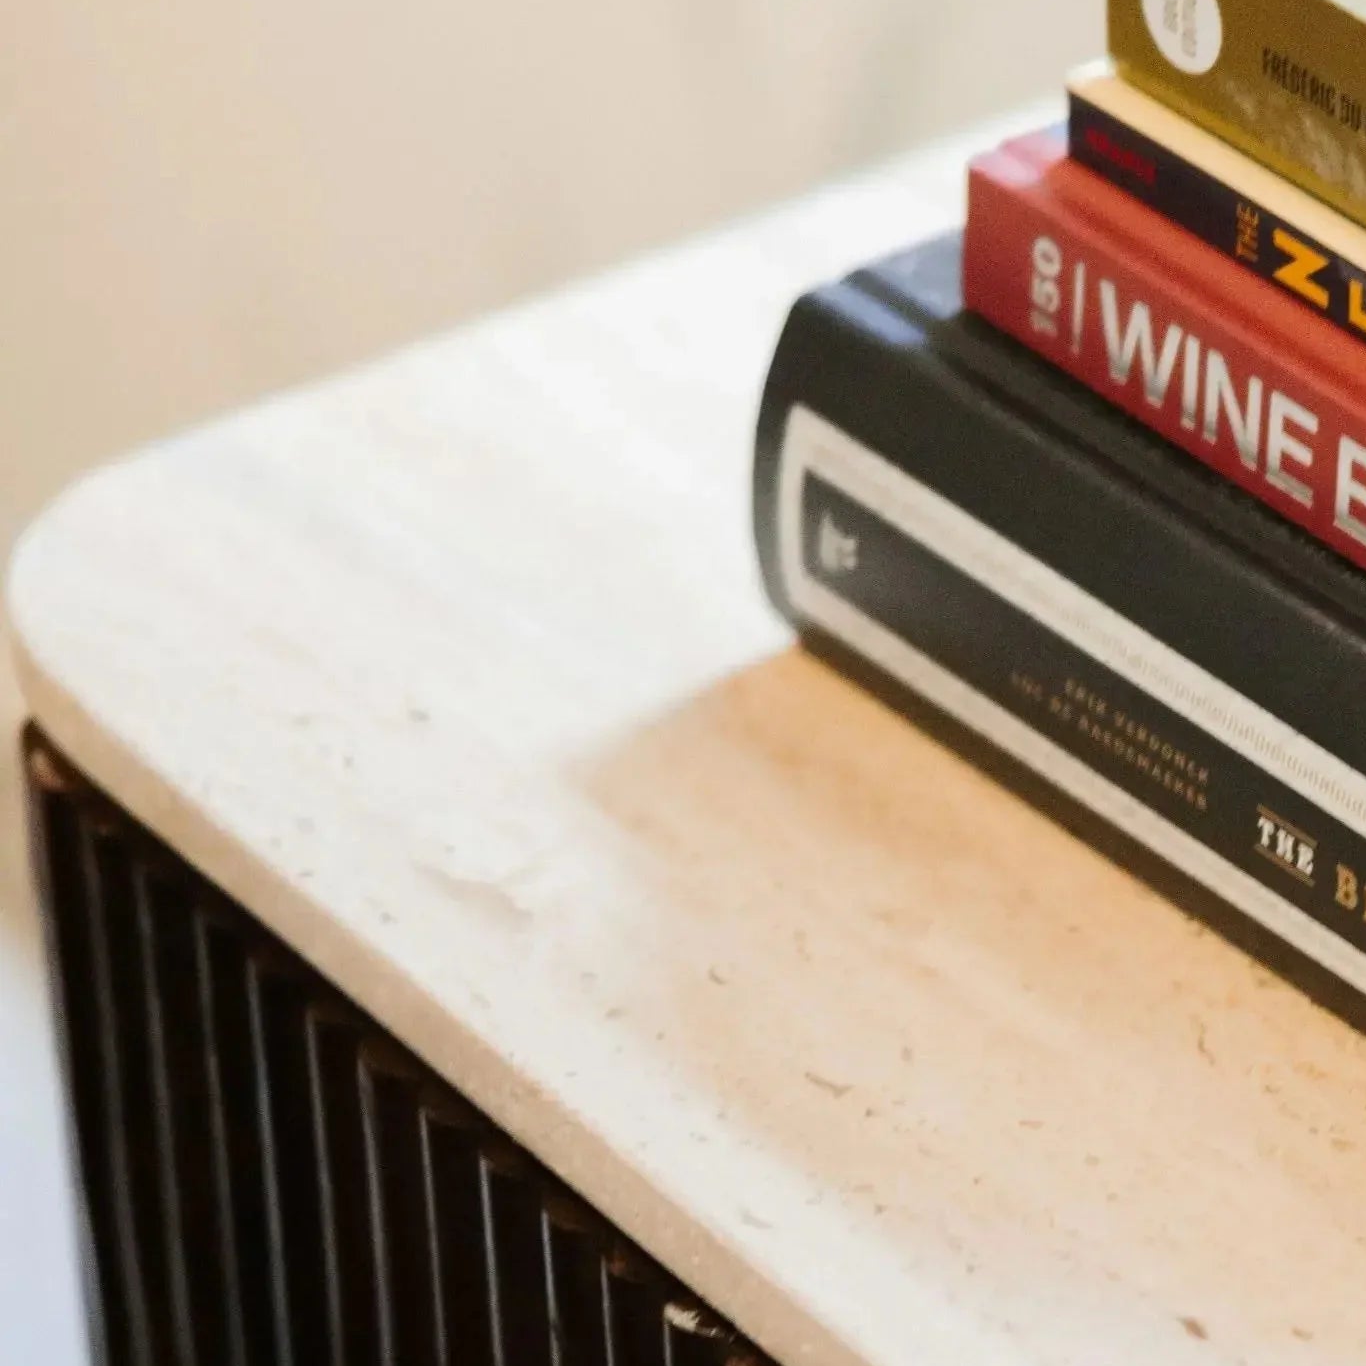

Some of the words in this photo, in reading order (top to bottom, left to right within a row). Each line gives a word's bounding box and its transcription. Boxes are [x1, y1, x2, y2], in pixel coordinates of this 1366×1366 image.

[1236, 201, 1260, 263] THE
[1030, 235, 1062, 337] 150
[1098, 278, 1320, 511] WINE
[1256, 813, 1316, 878] THE
